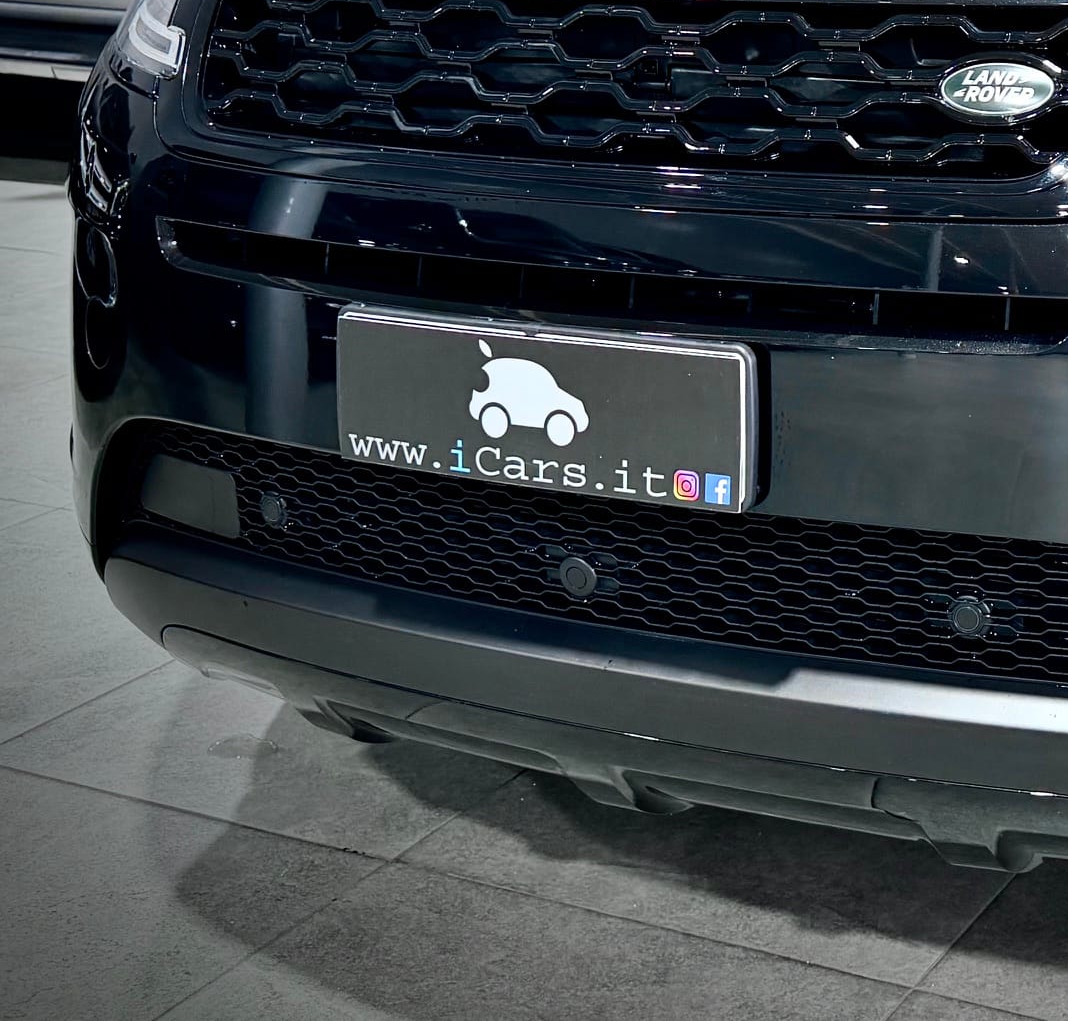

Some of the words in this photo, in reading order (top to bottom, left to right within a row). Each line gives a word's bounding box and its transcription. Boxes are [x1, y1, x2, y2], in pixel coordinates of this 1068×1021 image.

[962, 69, 1017, 85] LAND
[963, 85, 1035, 102] ROVER
[348, 433, 667, 498] www.iCars.it
